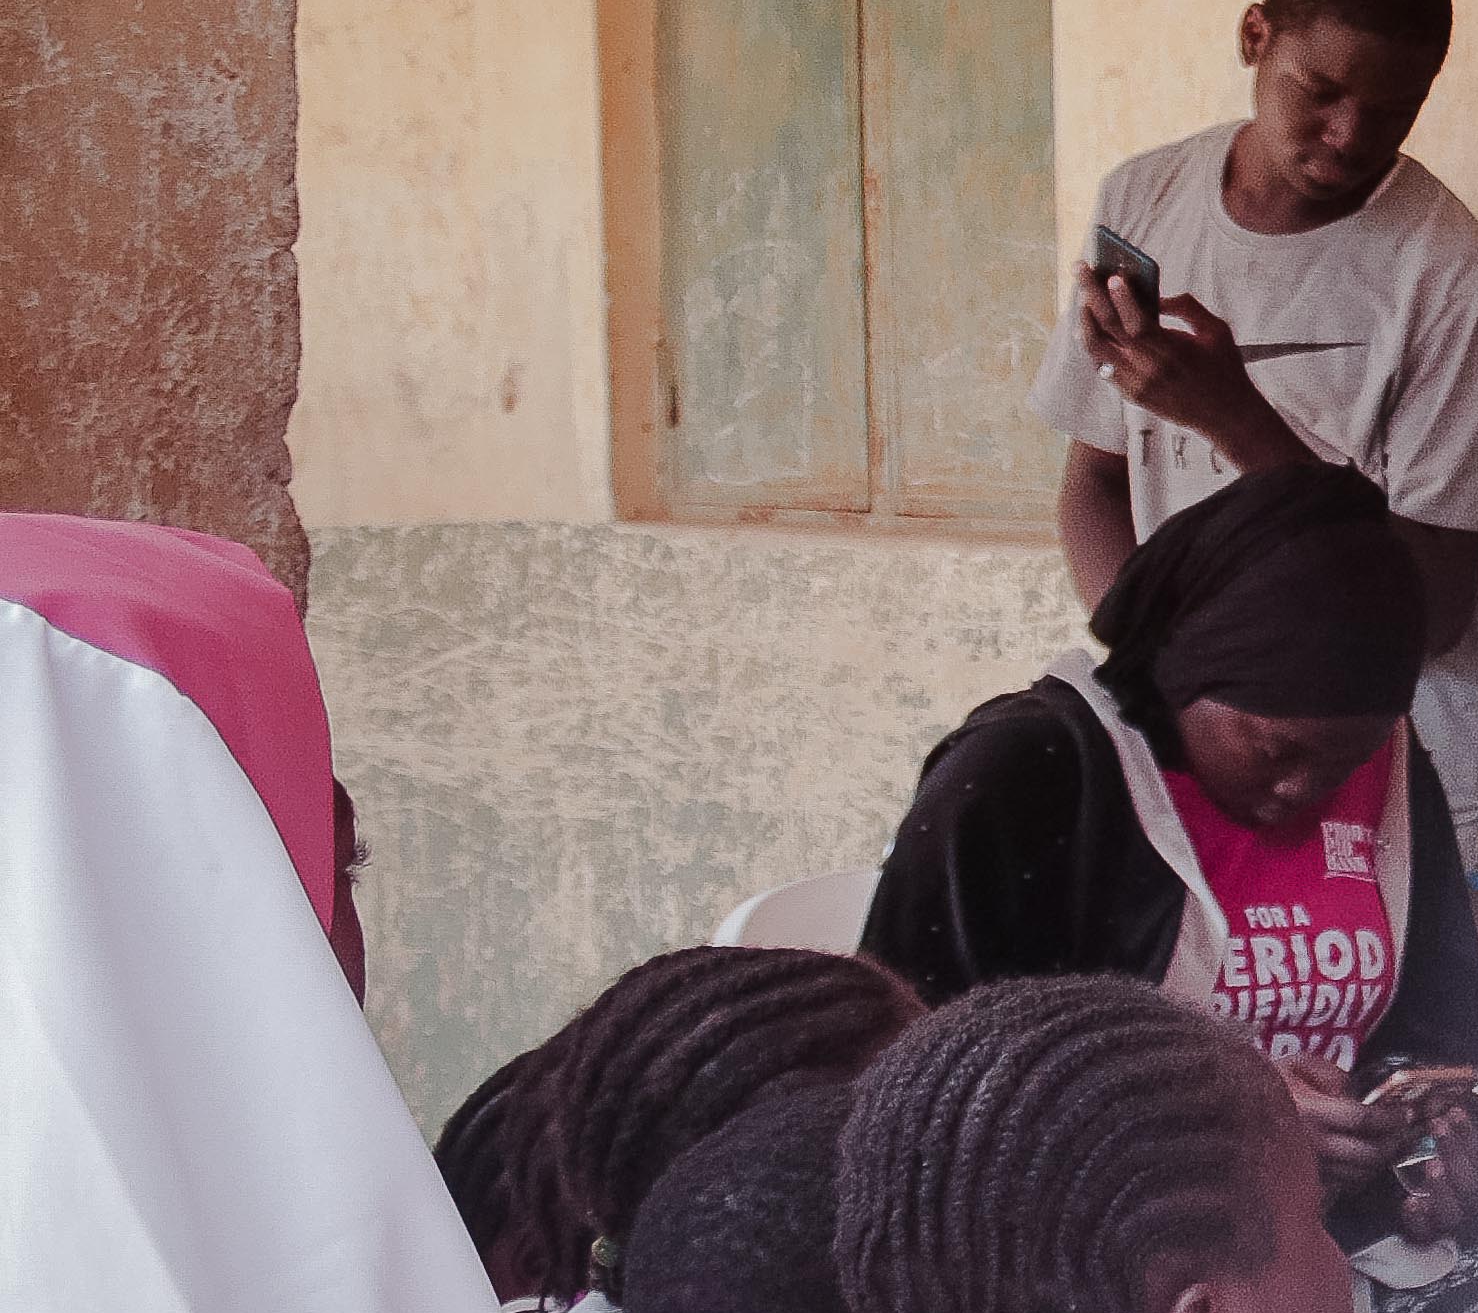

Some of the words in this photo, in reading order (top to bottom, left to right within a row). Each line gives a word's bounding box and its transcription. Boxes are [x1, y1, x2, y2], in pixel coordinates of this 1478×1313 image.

[1244, 903, 1289, 929] FOR
[1291, 902, 1312, 927] A
[1222, 928, 1387, 988] ERIOD
[1213, 983, 1385, 1028] RIENDLY
